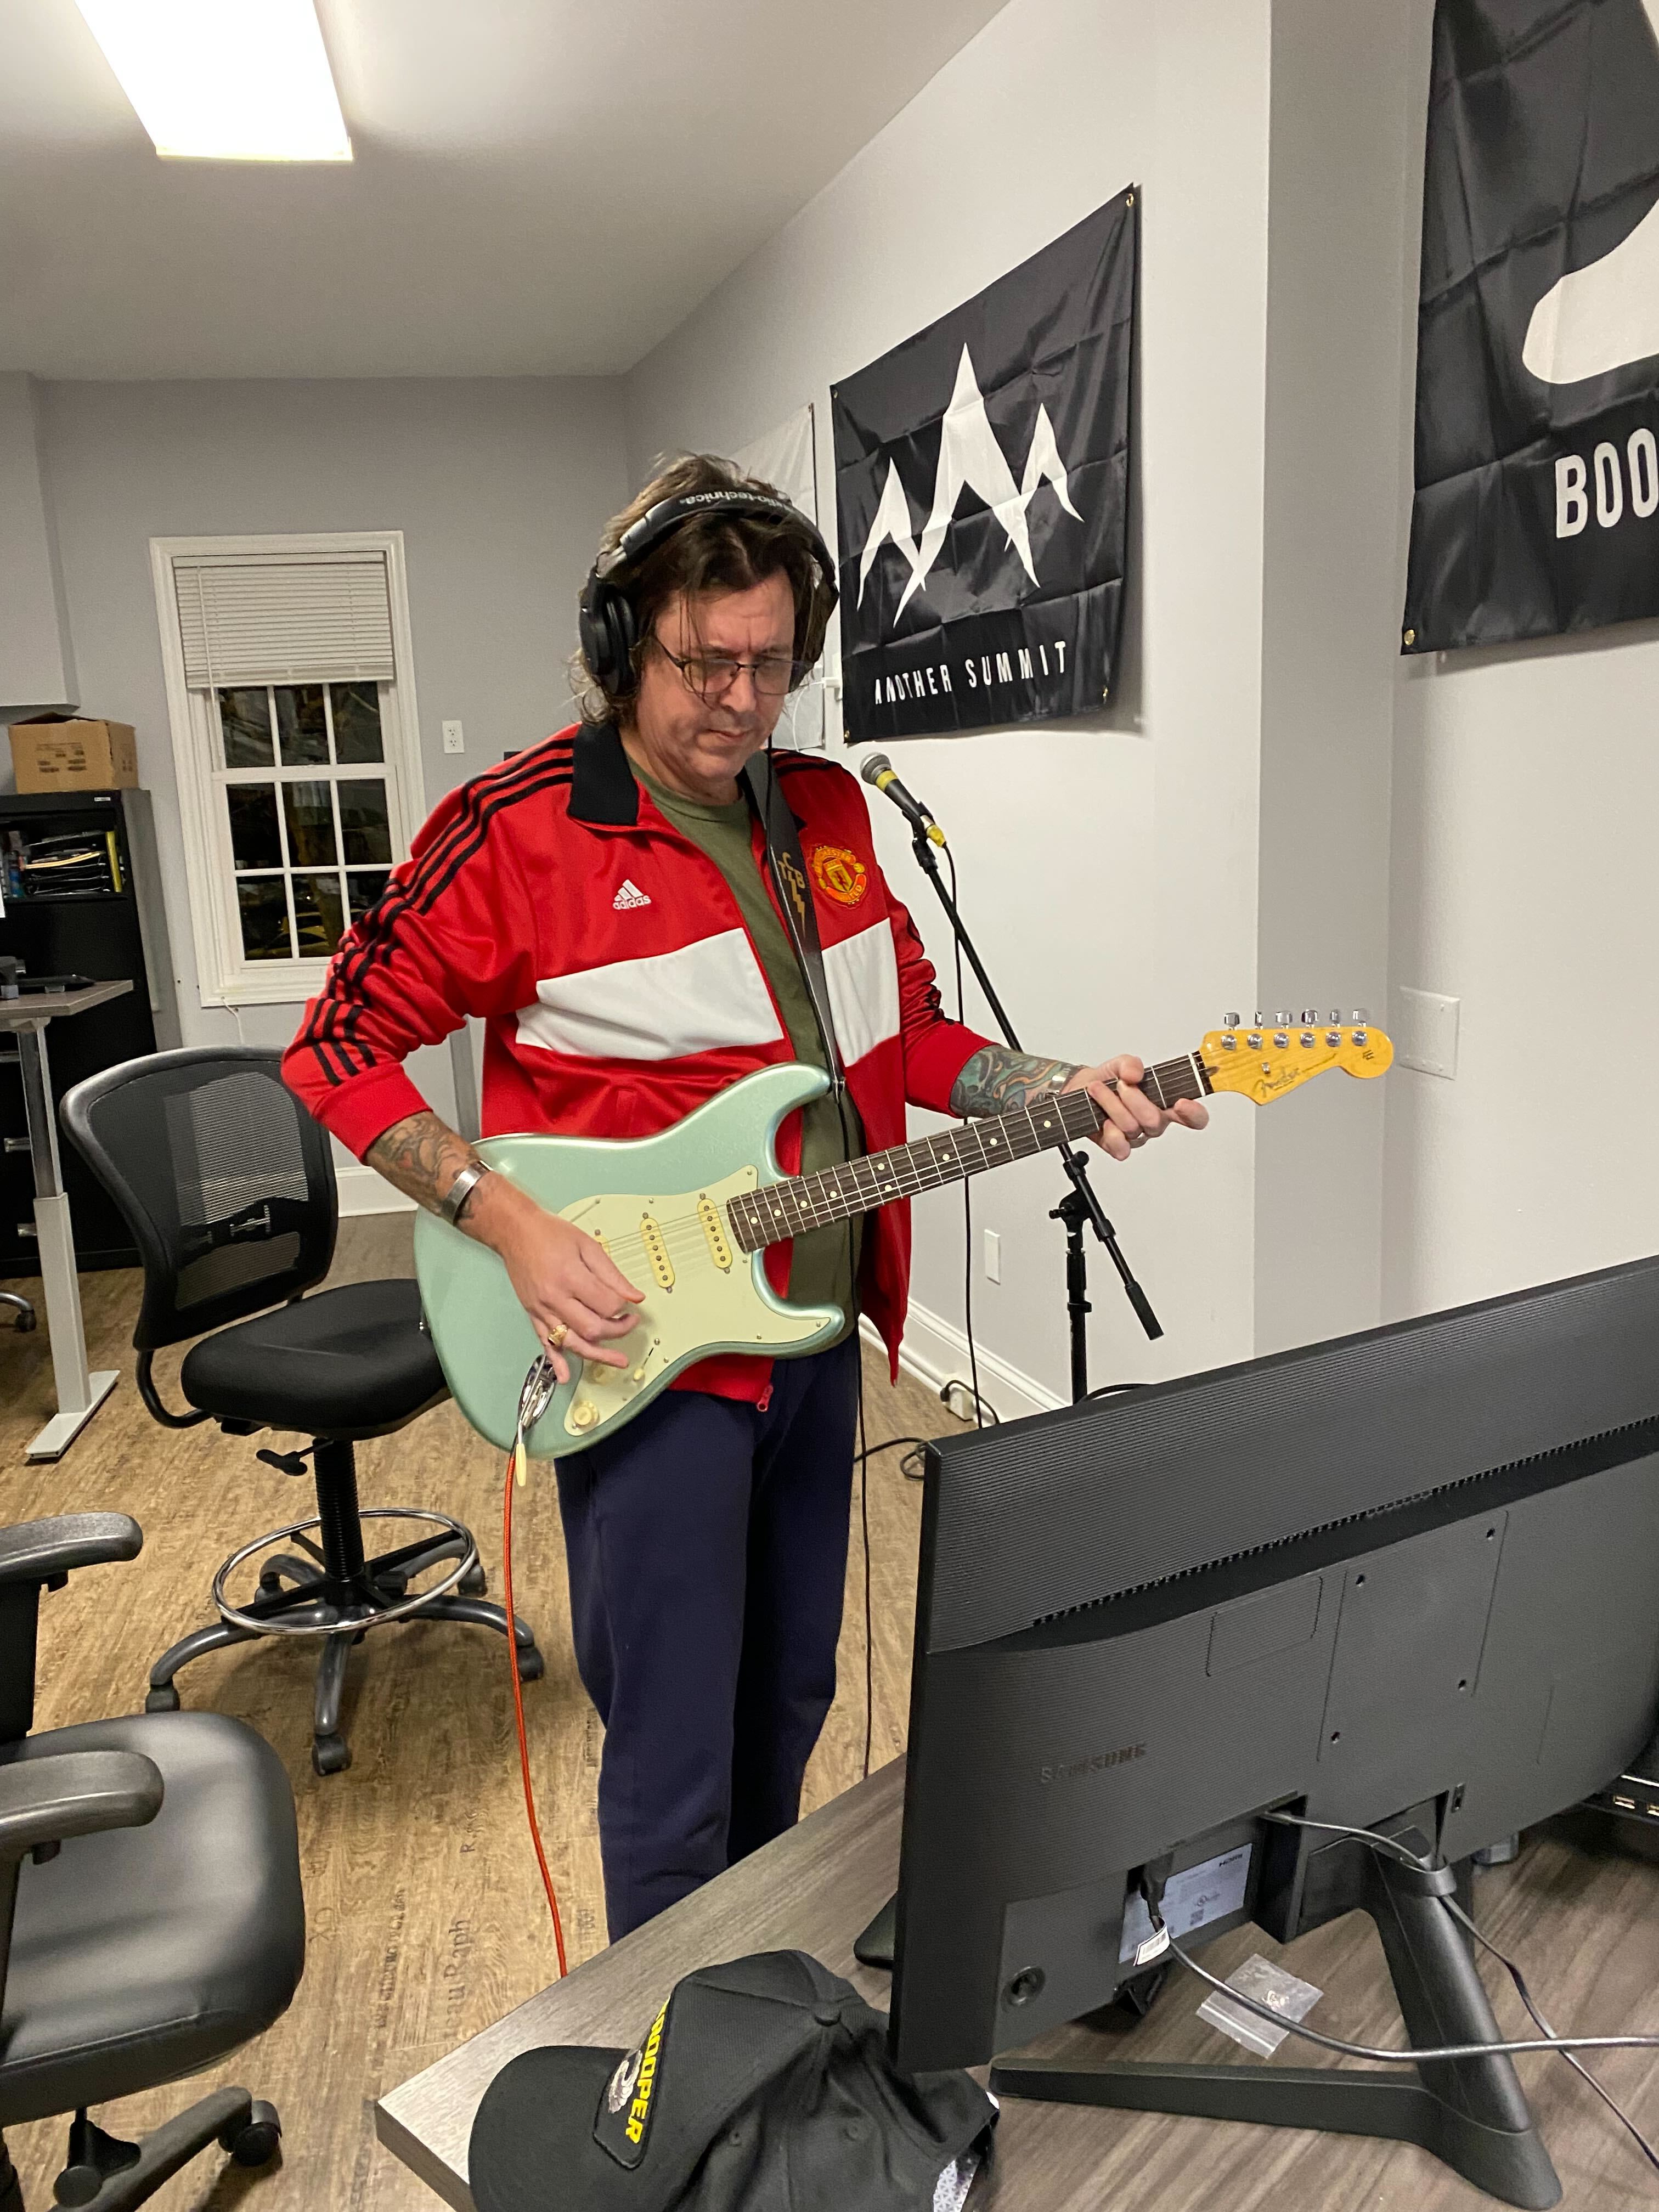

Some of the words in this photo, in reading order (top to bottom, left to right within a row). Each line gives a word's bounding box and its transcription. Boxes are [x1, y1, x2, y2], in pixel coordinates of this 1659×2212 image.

[1555, 428, 1658, 538] BOO
[874, 664, 952, 705] ANOTHER
[965, 641, 1066, 688] SUMMIT
[613, 895, 652, 910] adidas
